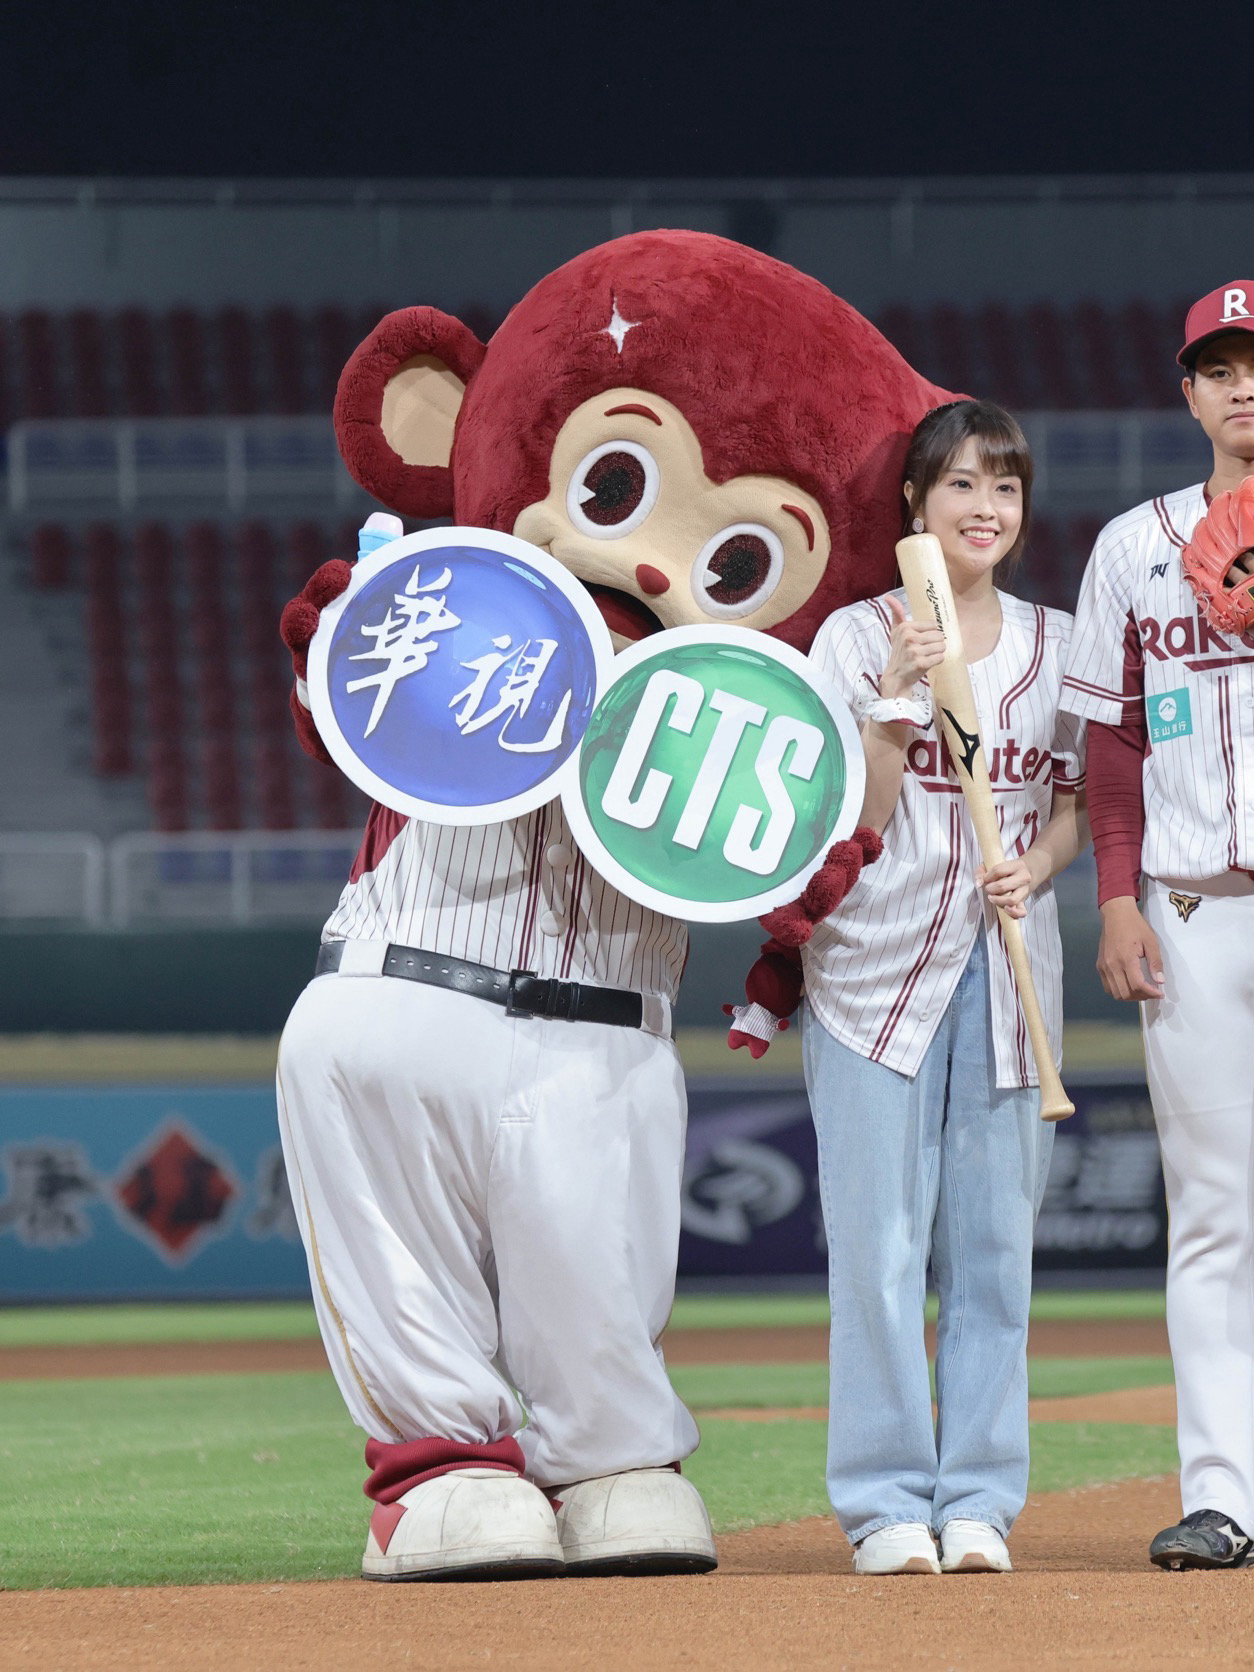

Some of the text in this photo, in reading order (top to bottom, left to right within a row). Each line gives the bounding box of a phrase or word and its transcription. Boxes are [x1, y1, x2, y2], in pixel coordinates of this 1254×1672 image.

[1223, 288, 1250, 318] R
[346, 564, 573, 754] 華視
[601, 668, 825, 876] CTS
